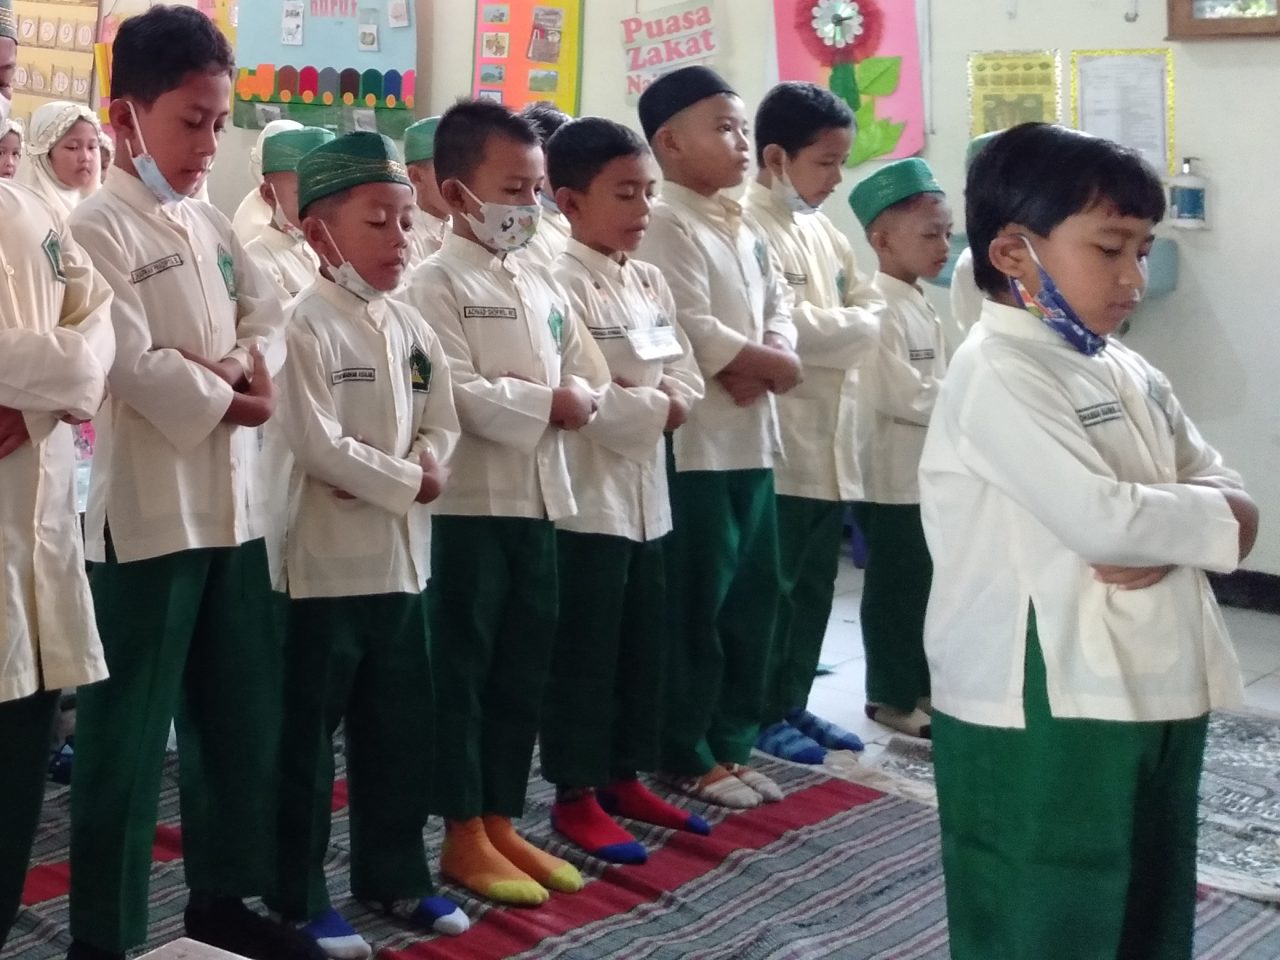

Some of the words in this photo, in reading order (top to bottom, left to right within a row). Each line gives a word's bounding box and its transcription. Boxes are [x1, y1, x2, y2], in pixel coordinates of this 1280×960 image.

[25, 23, 33, 36] 7
[621, 5, 712, 44] Puasa
[626, 28, 716, 72] Zakat
